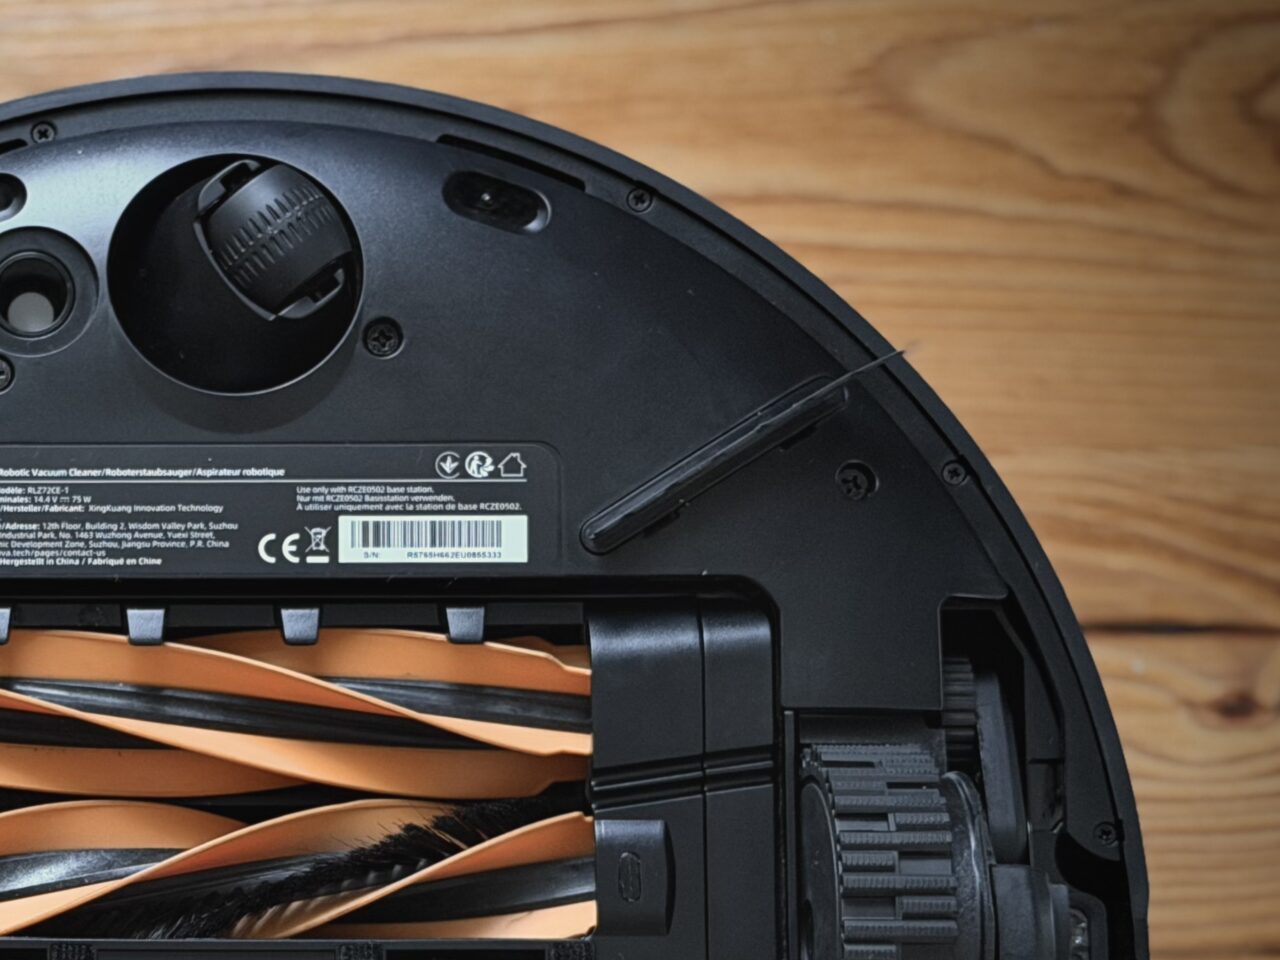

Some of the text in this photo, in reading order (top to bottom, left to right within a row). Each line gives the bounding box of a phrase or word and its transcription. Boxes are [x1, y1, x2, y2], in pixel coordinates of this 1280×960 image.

[31, 468, 67, 476] Vacuum
[68, 467, 241, 477] Cleaner/Roboterstaubsauger/Aspirateur
[242, 467, 285, 477] robotique
[311, 485, 329, 495] only
[329, 485, 347, 493] with
[385, 485, 405, 493] base
[405, 485, 434, 493] station.
[33, 495, 50, 503] 14.4
[51, 495, 58, 503] V
[71, 494, 82, 503] 75
[82, 495, 91, 503] W
[311, 494, 325, 502] mit
[409, 494, 455, 502] verwenden.
[133, 504, 176, 512] Innovation
[177, 503, 223, 514] Technology
[303, 502, 332, 511] utiliser
[333, 503, 383, 512] uniquement
[404, 502, 414, 510] la
[414, 502, 444, 510] station
[444, 502, 456, 510] de
[457, 502, 478, 510] base
[42, 521, 60, 530] 12th
[60, 521, 81, 530] Floor,
[84, 522, 118, 531] Building
[119, 522, 126, 531] 2,
[127, 522, 160, 530] Wisdom
[160, 521, 186, 531] Valley
[186, 521, 206, 530] Park,
[208, 521, 238, 530] Suzhou
[36, 530, 57, 540] Park,
[94, 531, 132, 540] Wuzhong
[132, 531, 165, 539] Avenue,
[189, 531, 215, 539] Street,
[10, 540, 63, 549] Development
[63, 540, 87, 549] Zone,
[88, 540, 120, 549] Suzhou,
[151, 540, 186, 548] Province,
[205, 539, 229, 548] China
[45, 556, 54, 565] in
[55, 556, 80, 565] China
[125, 557, 137, 565] en
[137, 556, 162, 565] Chine
